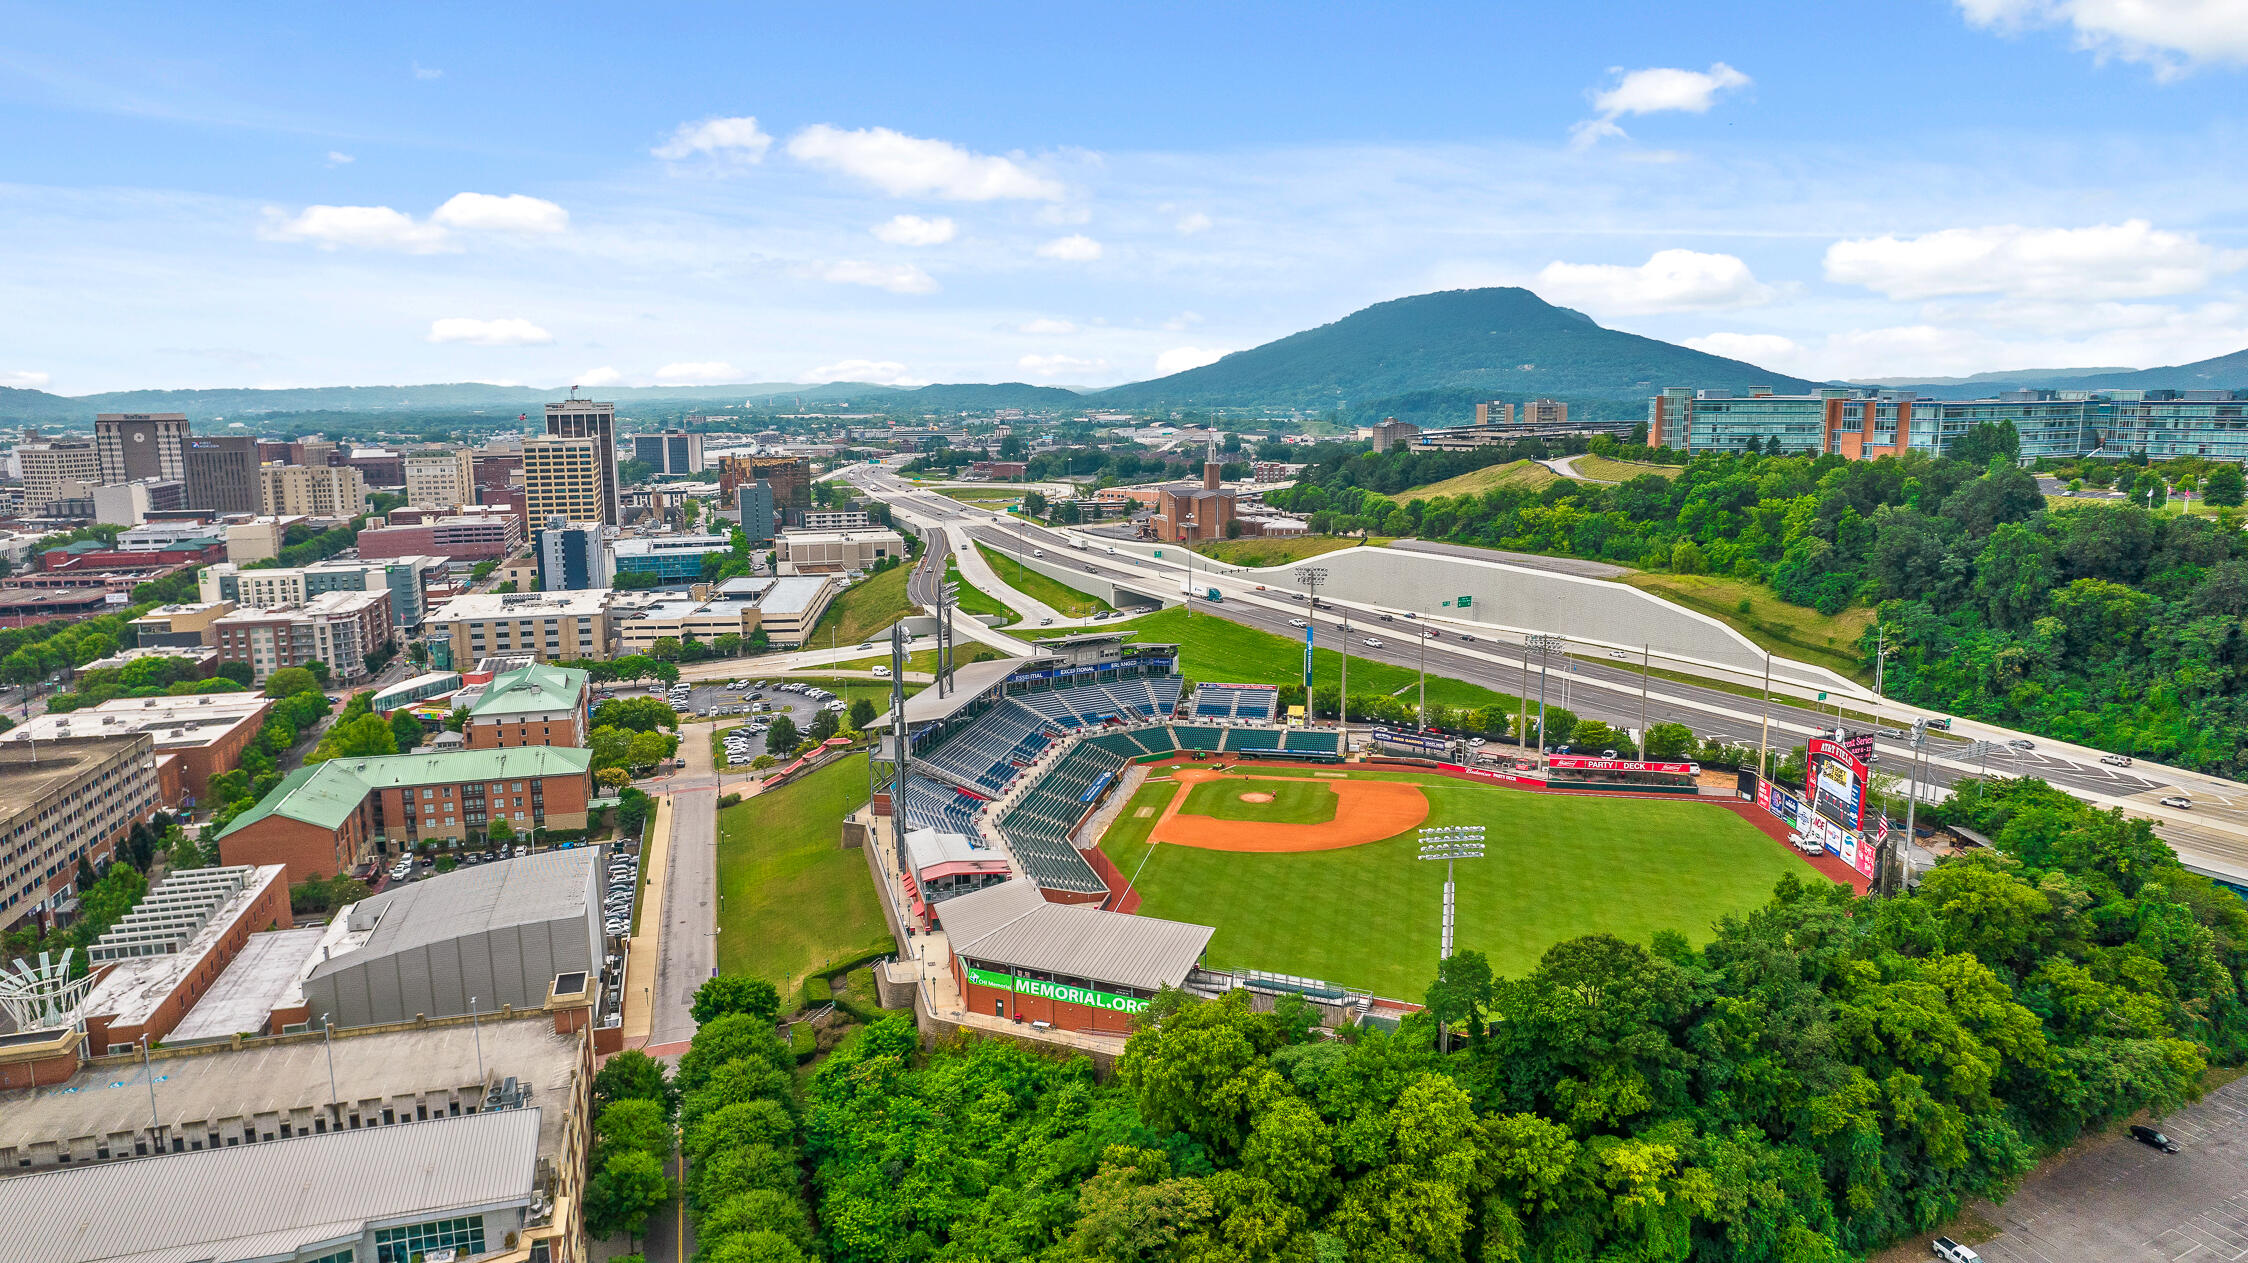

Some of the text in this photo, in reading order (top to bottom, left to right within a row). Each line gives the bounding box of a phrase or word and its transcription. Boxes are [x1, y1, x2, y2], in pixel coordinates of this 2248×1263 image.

[1820, 742, 1854, 767] AT&T FIELD
[1588, 761, 1614, 769] PARTY
[1813, 816, 1825, 830] ACE
